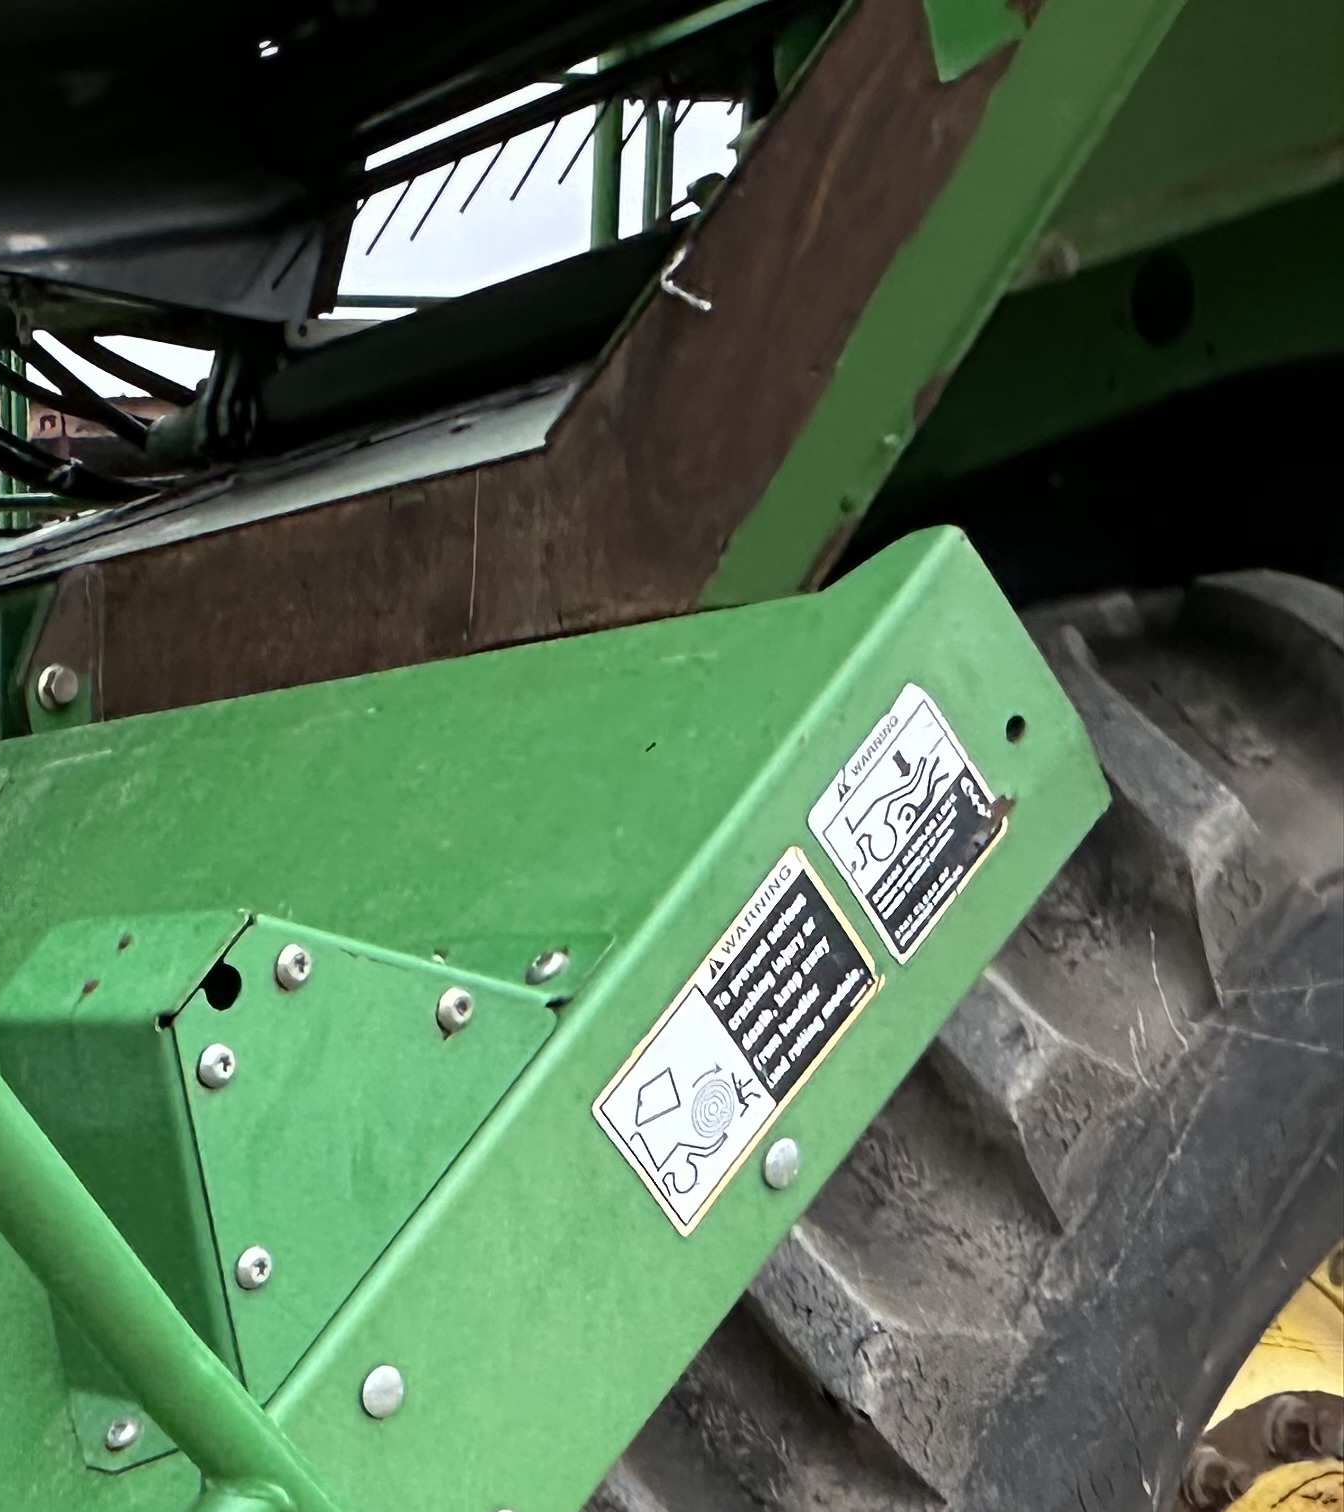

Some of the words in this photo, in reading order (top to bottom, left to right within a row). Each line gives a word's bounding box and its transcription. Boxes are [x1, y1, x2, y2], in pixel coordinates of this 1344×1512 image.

[713, 990, 731, 1010] To
[728, 939, 769, 996] prevent
[767, 893, 806, 944] serious
[720, 864, 792, 954] WARNING
[728, 971, 775, 1030] crushing
[771, 932, 804, 974] injury
[802, 916, 815, 936] or
[741, 1004, 778, 1050] death,
[773, 971, 802, 1007] keep
[800, 936, 829, 974] away
[753, 1033, 782, 1070] from
